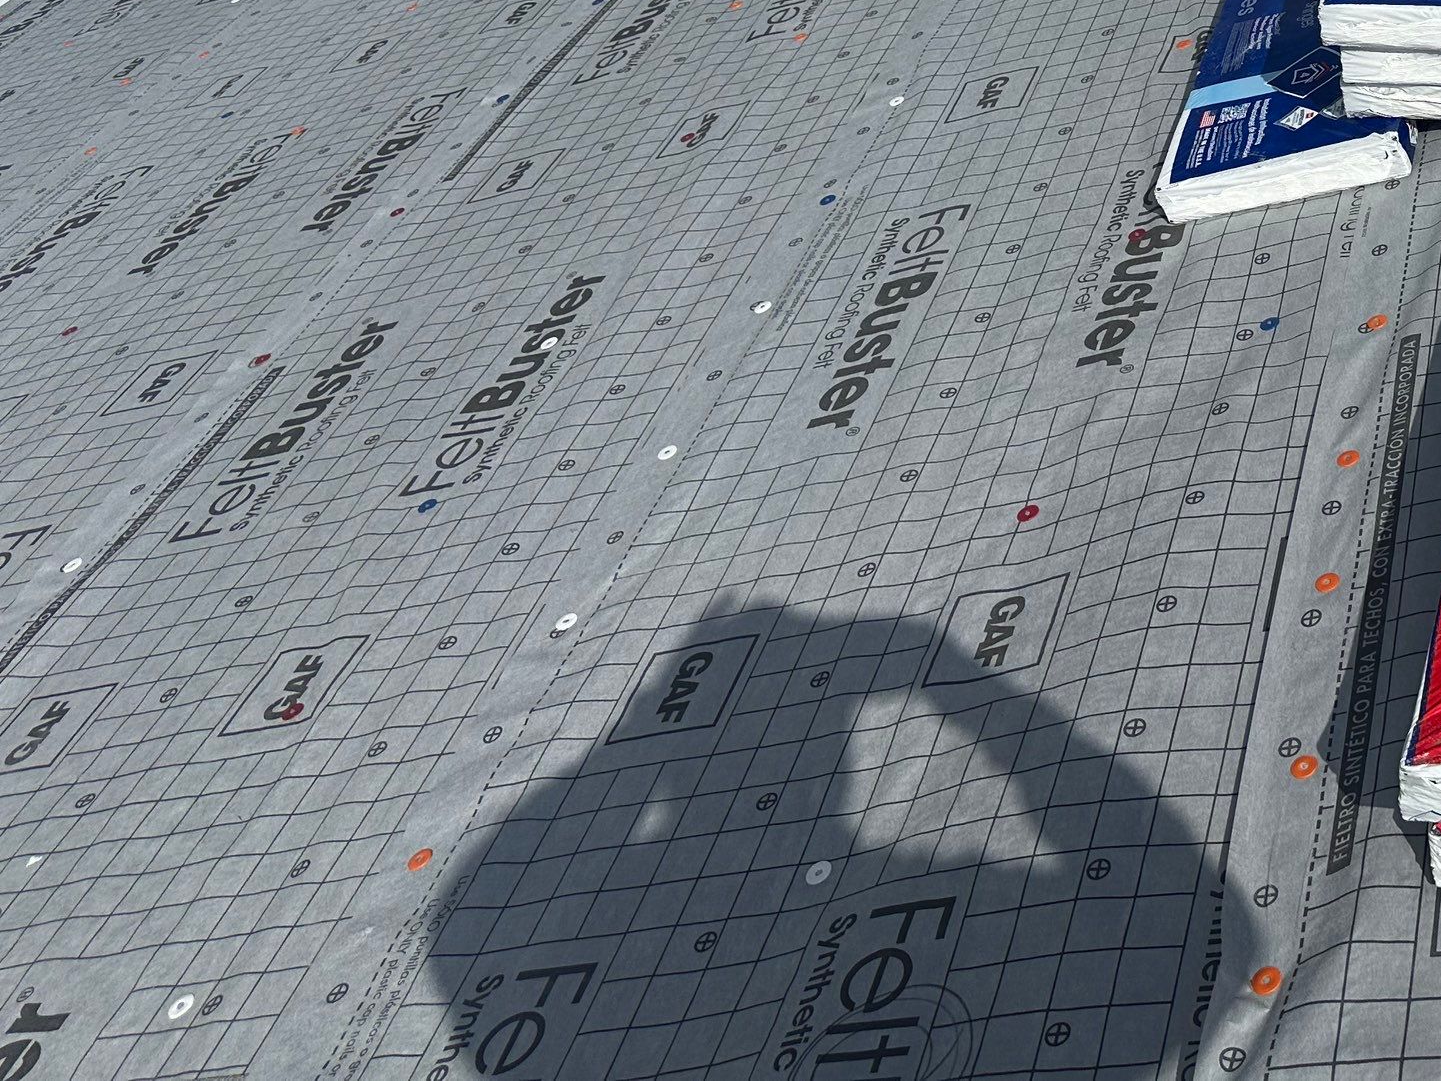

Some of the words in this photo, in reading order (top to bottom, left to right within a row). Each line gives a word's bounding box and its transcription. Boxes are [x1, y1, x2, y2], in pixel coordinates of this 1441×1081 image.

[505, 2, 536, 26] GAF
[977, 76, 1010, 110] GAF
[301, 88, 465, 232] FeltBuster
[497, 159, 534, 193] GAF
[127, 127, 308, 277] FeltBuster
[1114, 168, 1145, 232] Synthetic
[863, 217, 911, 281] Synthetic
[1076, 231, 1123, 284] Roofing
[807, 204, 972, 429] FeltBuster
[824, 282, 876, 341] Roofing
[138, 362, 188, 403] GAF
[399, 274, 606, 497] FeltBuster
[1393, 340, 1417, 426] INCORPORADA
[169, 320, 399, 544] FeltBuster
[462, 405, 529, 485] Synthetic
[523, 345, 576, 407] Roofing
[229, 449, 303, 534] Synthetic
[1377, 428, 1406, 543] EXTRA-TRACCIÓN
[1371, 544, 1391, 578] CON
[975, 595, 1026, 667] GAF
[1361, 580, 1389, 648] TECHOS,
[262, 654, 323, 721] GAF
[656, 651, 714, 723] GAF
[1356, 651, 1377, 694] PARA
[6, 701, 71, 764] GAF
[1345, 698, 1371, 786] SINTÉTICO
[1334, 791, 1357, 861] FIELTRO
[397, 918, 424, 957] ONLY
[420, 898, 438, 921] Use
[373, 958, 400, 1002] plastic
[397, 936, 429, 987] puntillas
[773, 912, 858, 1071] Synthetic
[340, 1030, 361, 1061] nails
[356, 1002, 376, 1028] cap
[328, 1064, 341, 1078] or
